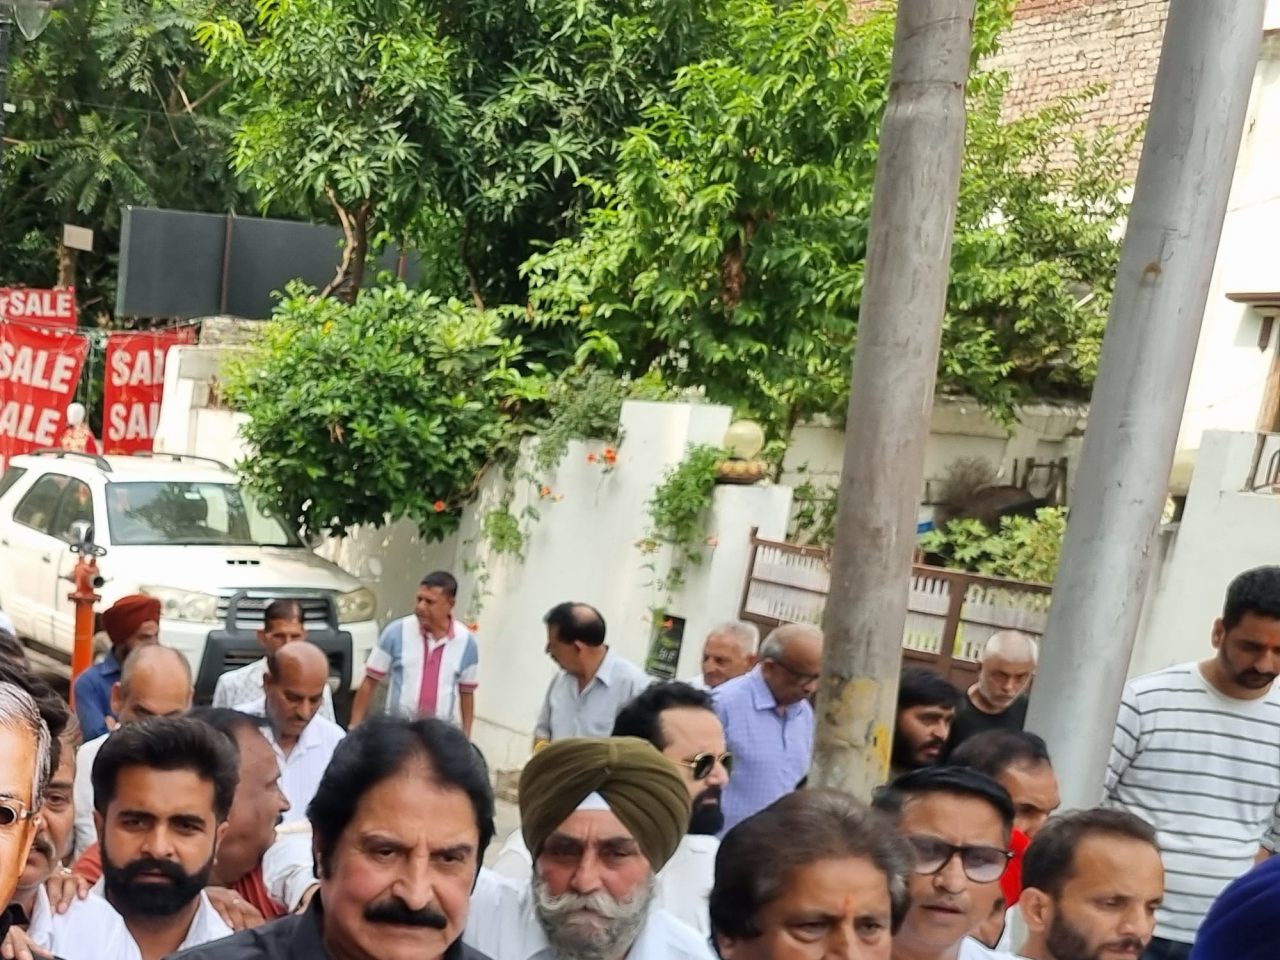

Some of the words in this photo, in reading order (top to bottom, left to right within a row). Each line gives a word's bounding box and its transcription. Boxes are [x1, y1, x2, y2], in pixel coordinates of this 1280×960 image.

[9, 290, 72, 317] SALE
[111, 349, 165, 387] SAL
[108, 402, 160, 441] SAL
